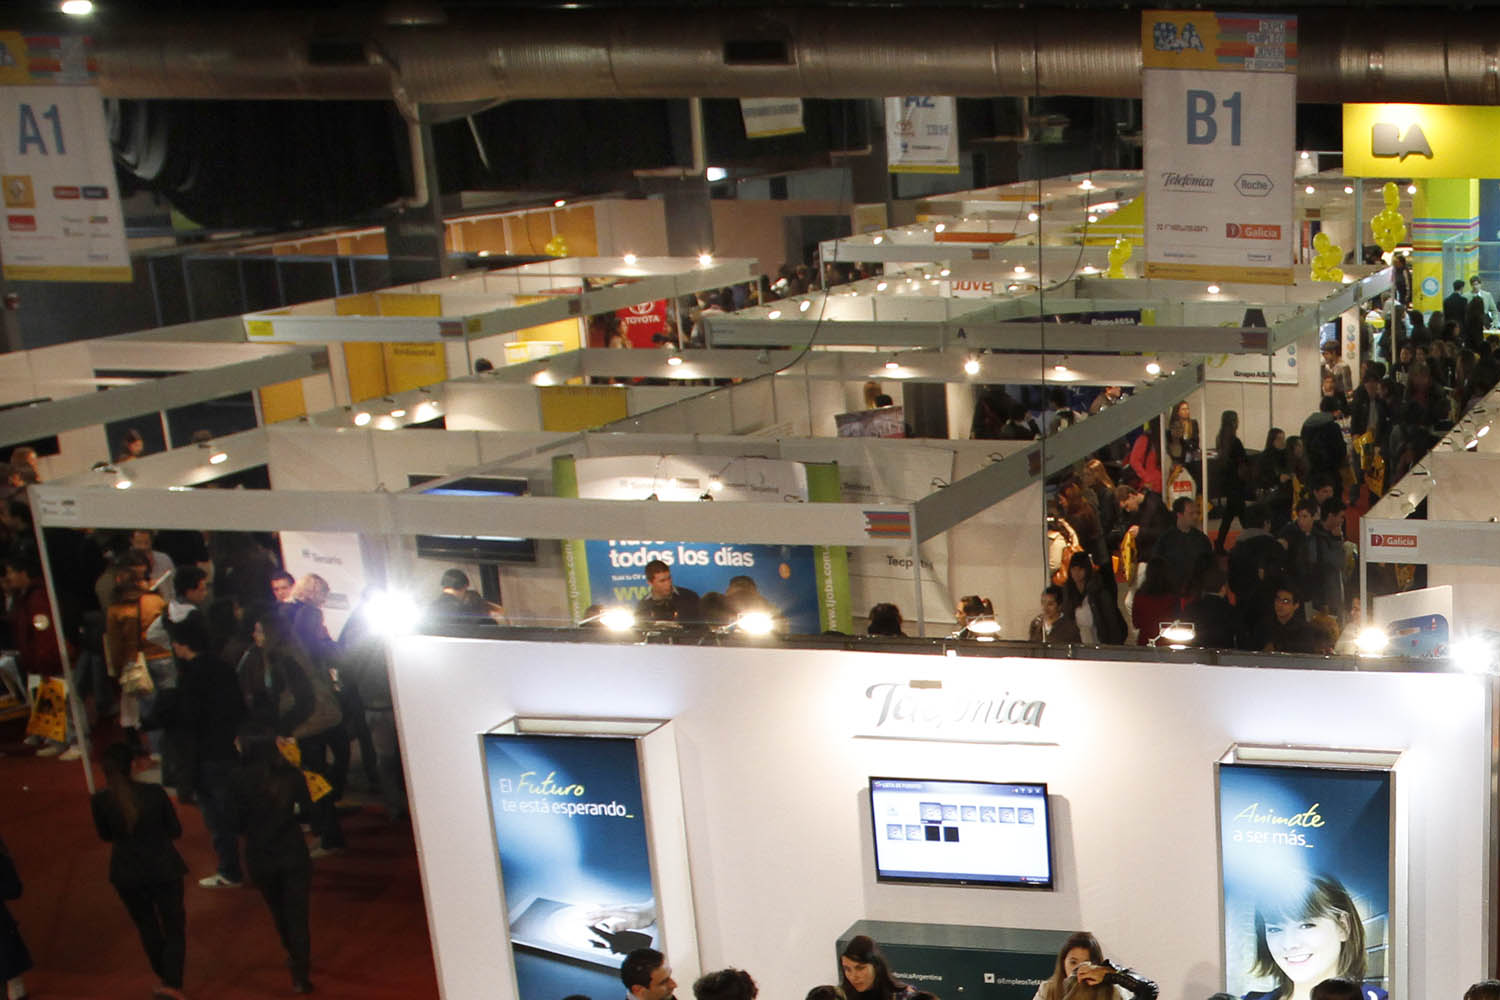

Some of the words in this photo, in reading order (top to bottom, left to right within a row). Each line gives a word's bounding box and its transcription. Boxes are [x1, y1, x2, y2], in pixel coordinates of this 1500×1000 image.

[1187, 89, 1242, 146] B1
[19, 104, 66, 155] A1
[1241, 179, 1268, 190] Roche
[1245, 226, 1278, 238] Galicia
[625, 315, 660, 324] TOYOTA
[1387, 537, 1415, 546] Galicia
[609, 546, 675, 568] todos
[678, 546, 709, 566] los
[714, 546, 755, 568] días
[865, 683, 1047, 728] Tenica
[501, 778, 512, 793] El
[517, 771, 585, 796] Futuro
[503, 800, 515, 812] te
[519, 798, 550, 814] está
[1233, 803, 1326, 828] Animate
[1233, 831, 1243, 841] a
[1245, 831, 1269, 843] ser
